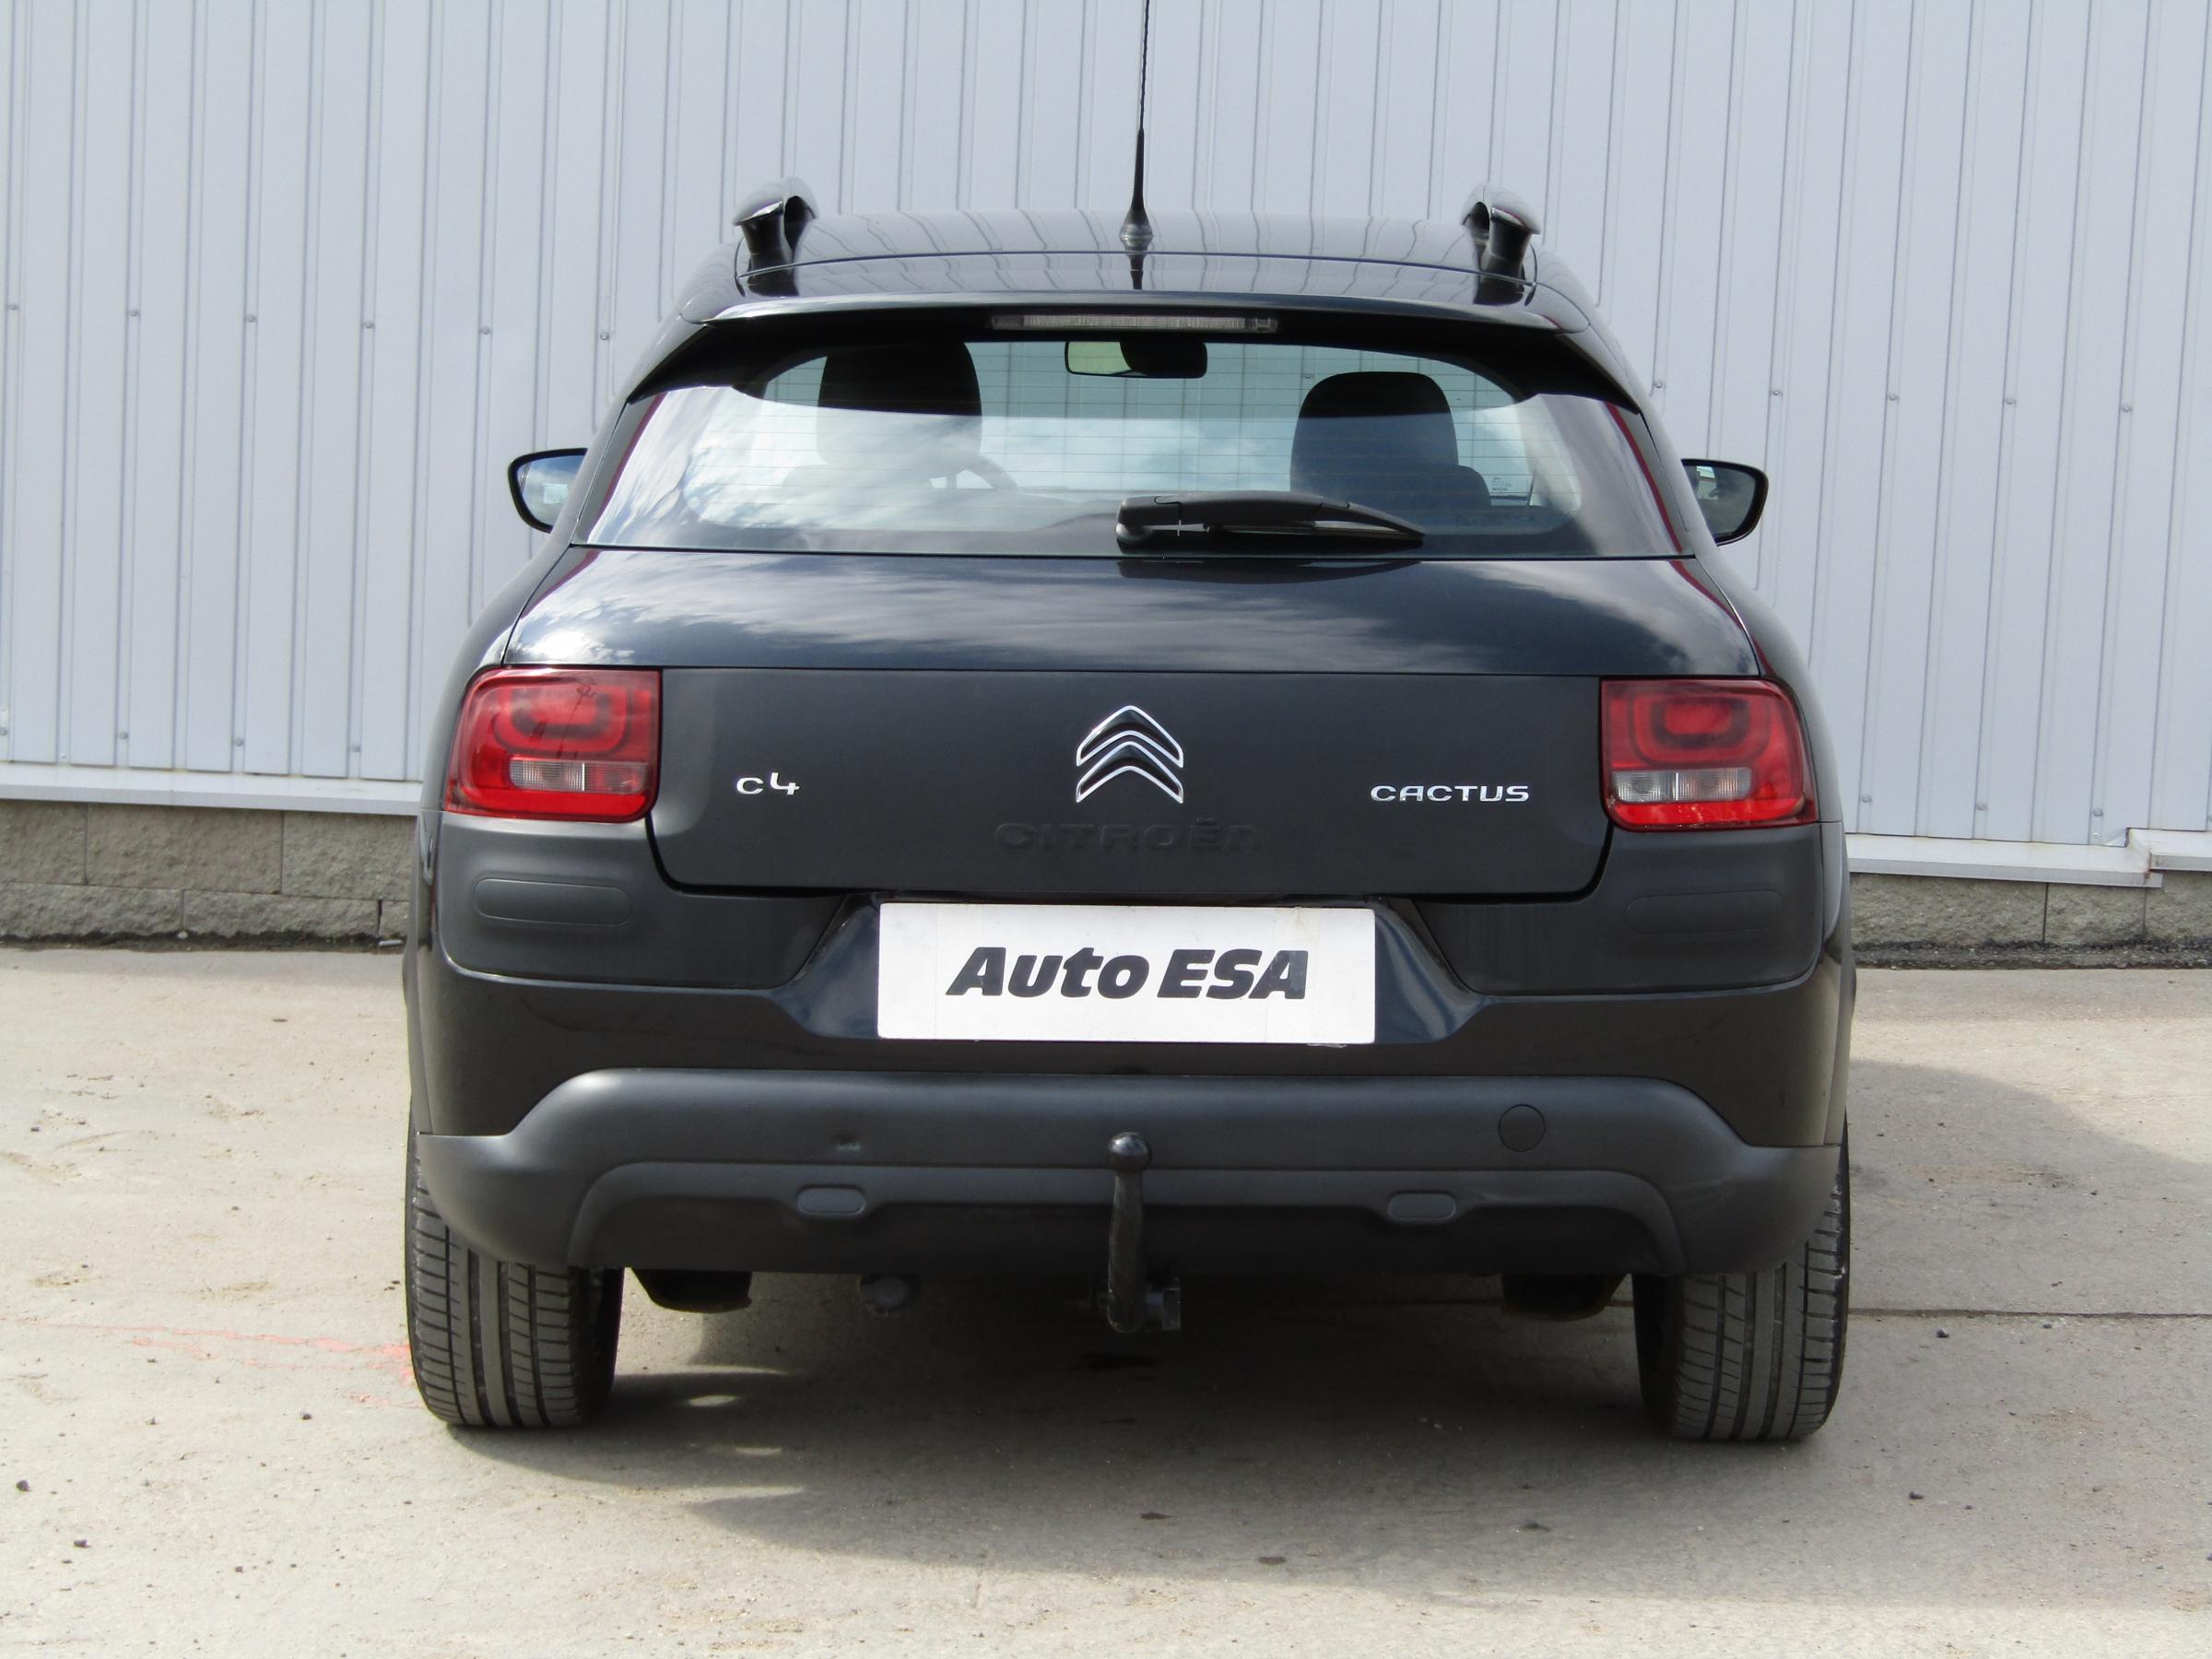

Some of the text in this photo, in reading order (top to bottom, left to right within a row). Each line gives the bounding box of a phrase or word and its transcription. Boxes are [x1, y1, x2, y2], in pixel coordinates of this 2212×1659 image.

[1369, 784, 1530, 804] CACTUS
[946, 947, 1309, 1000] Auto ESA
